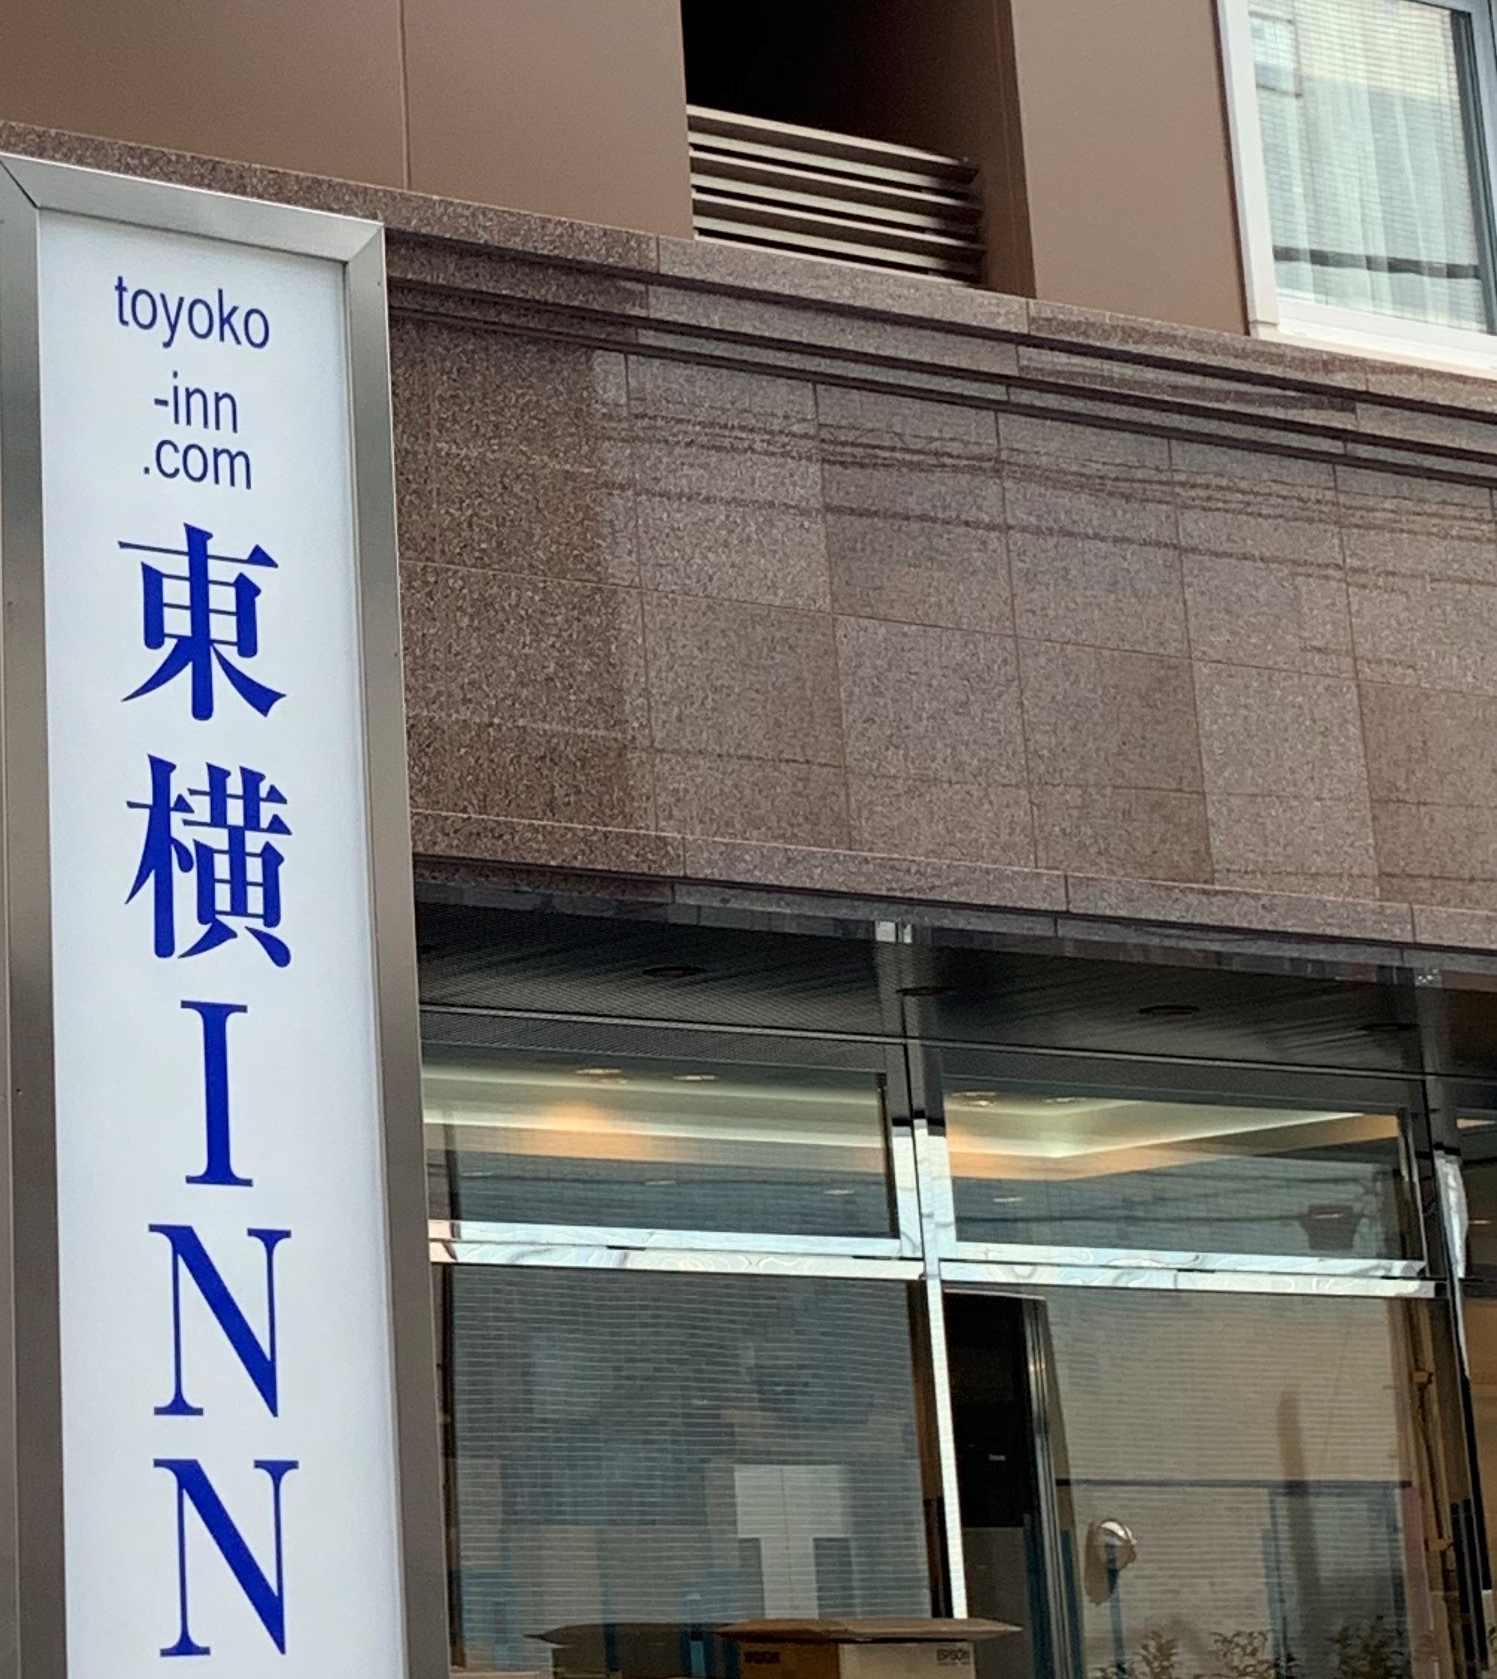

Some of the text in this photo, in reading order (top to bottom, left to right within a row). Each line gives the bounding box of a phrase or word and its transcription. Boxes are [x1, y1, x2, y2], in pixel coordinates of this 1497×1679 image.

[114, 276, 271, 348] toyoko
[153, 371, 239, 434] -inn
[143, 438, 253, 490] .com
